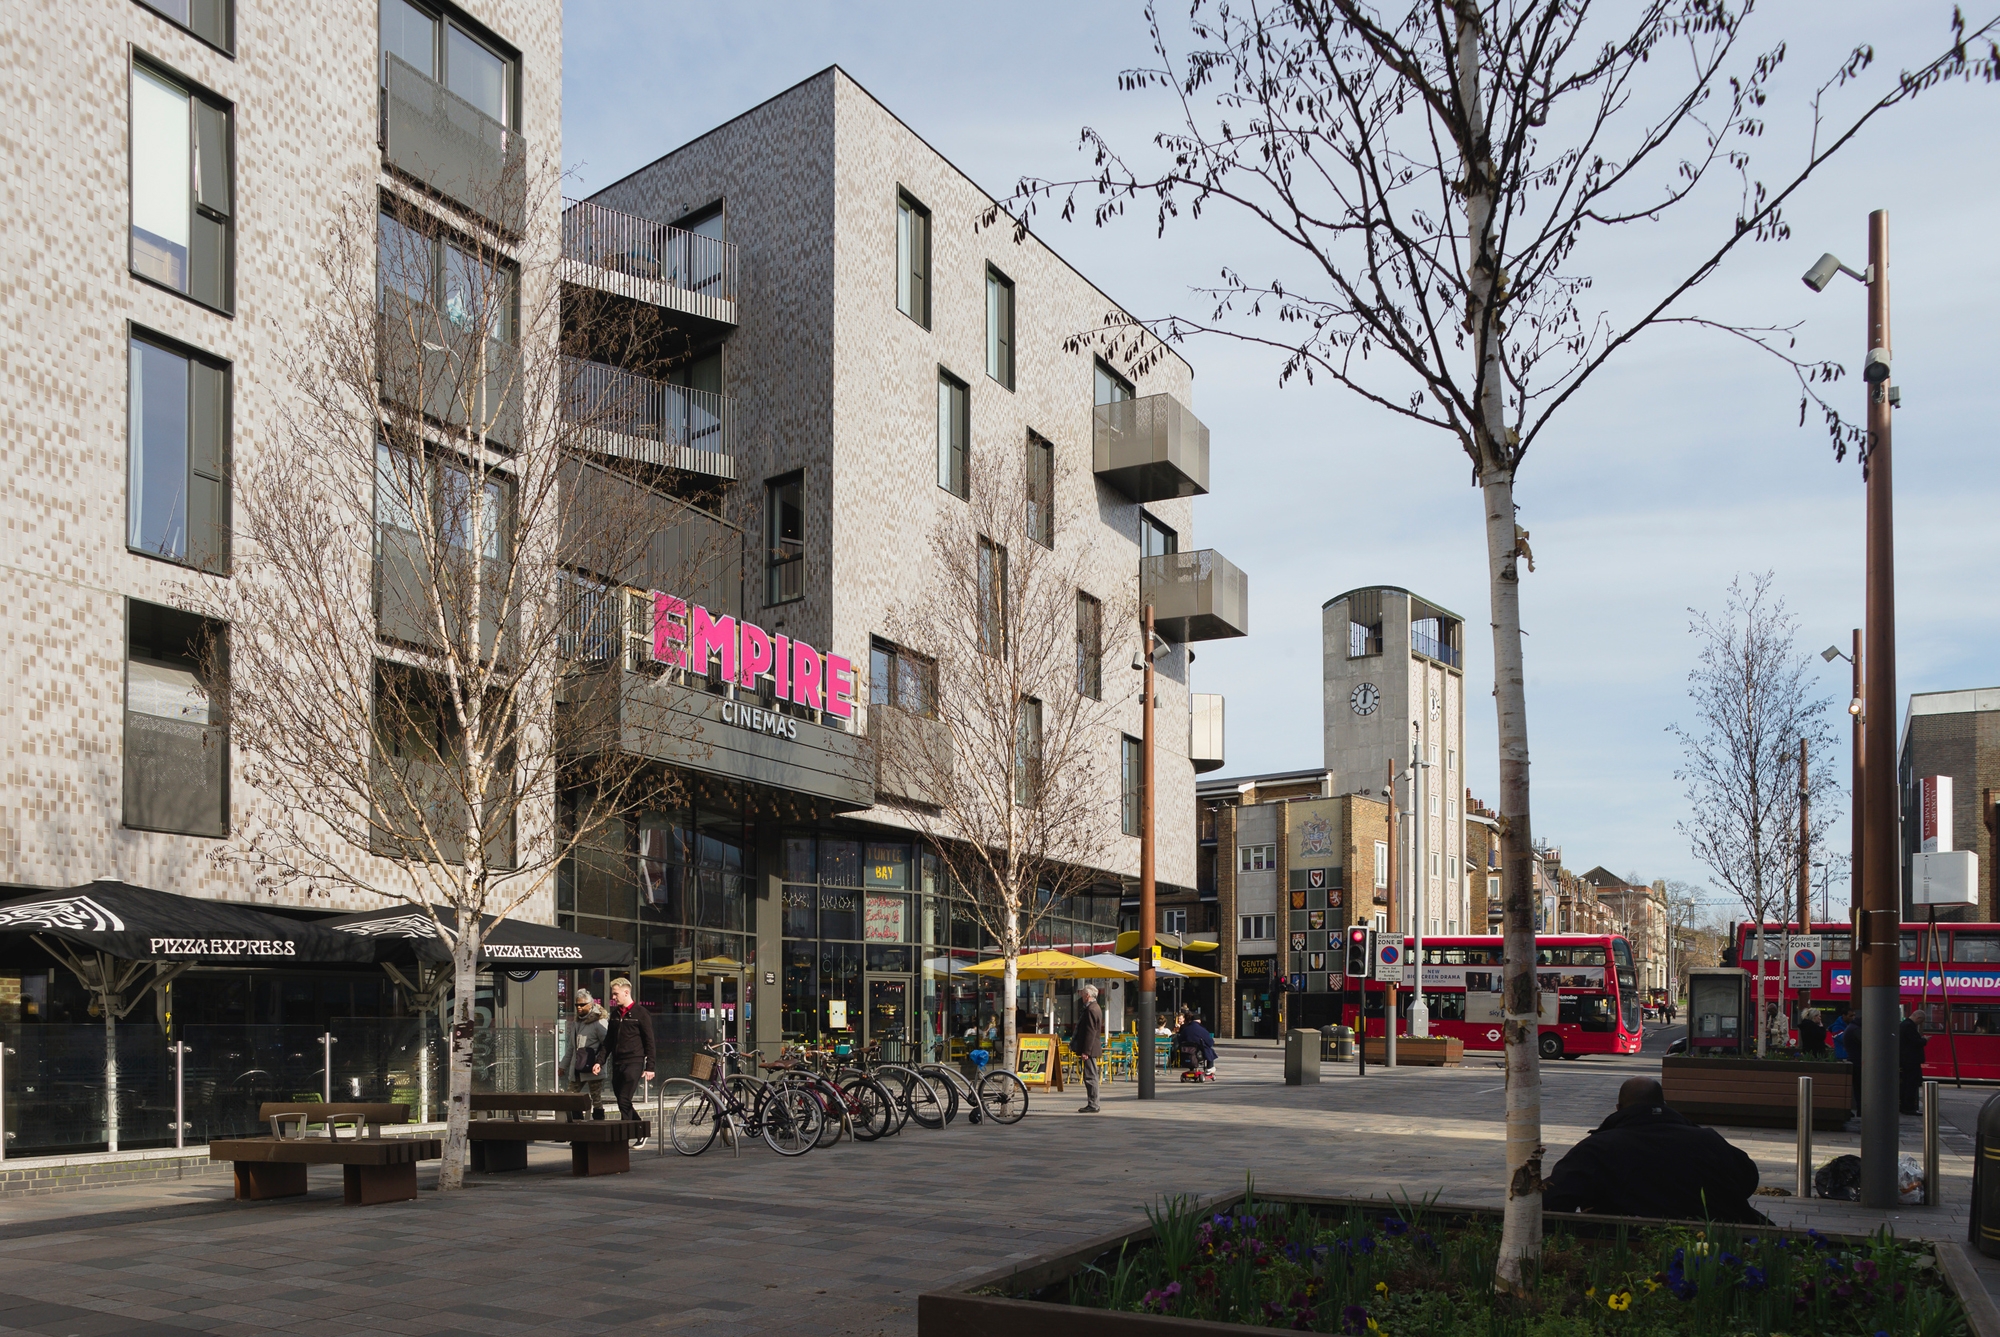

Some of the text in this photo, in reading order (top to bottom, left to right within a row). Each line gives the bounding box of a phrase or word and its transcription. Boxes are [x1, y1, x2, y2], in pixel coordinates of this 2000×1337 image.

[653, 590, 851, 719] EMPIRE
[722, 700, 797, 739] CINEMAS
[867, 847, 902, 862] TURTLE
[876, 866, 894, 880] BAY
[1241, 960, 1268, 968] CENTR
[1489, 1009, 1500, 1017] sky
